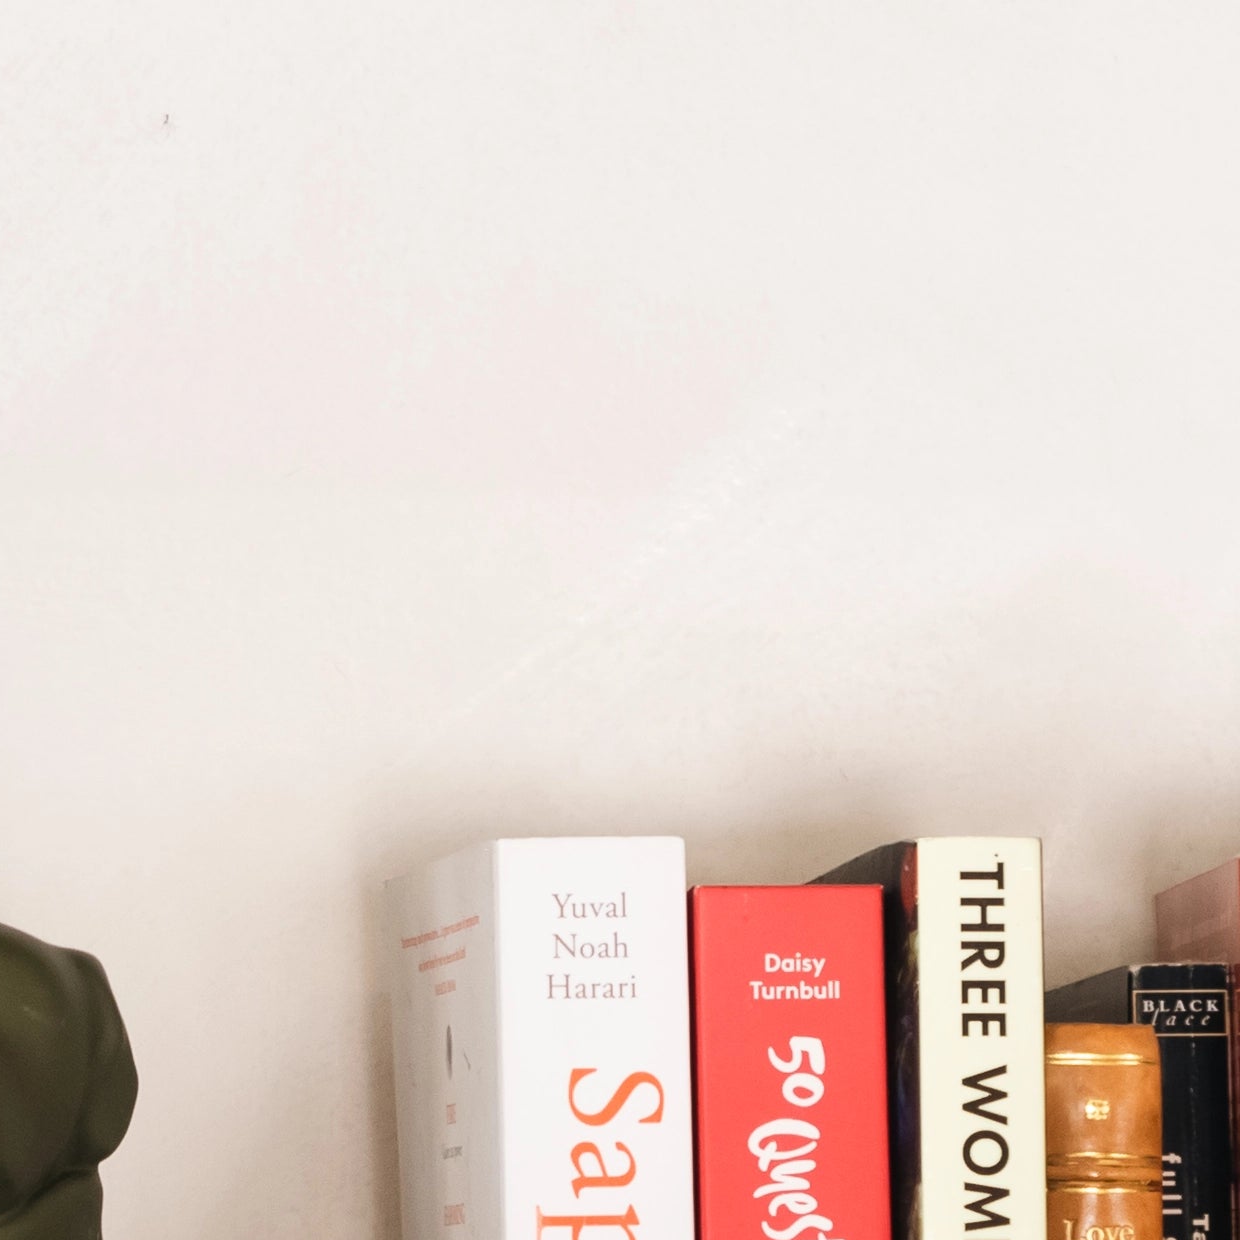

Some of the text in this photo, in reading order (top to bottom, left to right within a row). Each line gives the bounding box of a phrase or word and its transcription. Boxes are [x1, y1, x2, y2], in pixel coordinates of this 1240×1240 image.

[552, 892, 628, 920] Yuval
[552, 933, 629, 960] Noah
[959, 861, 1008, 1038] THREE
[764, 953, 827, 975] Daisy
[546, 974, 638, 1001] Harari
[749, 980, 841, 1000] Turnbull
[1142, 999, 1220, 1012] BLACK
[1151, 1008, 1211, 1026] lace
[767, 1035, 826, 1108] 50
